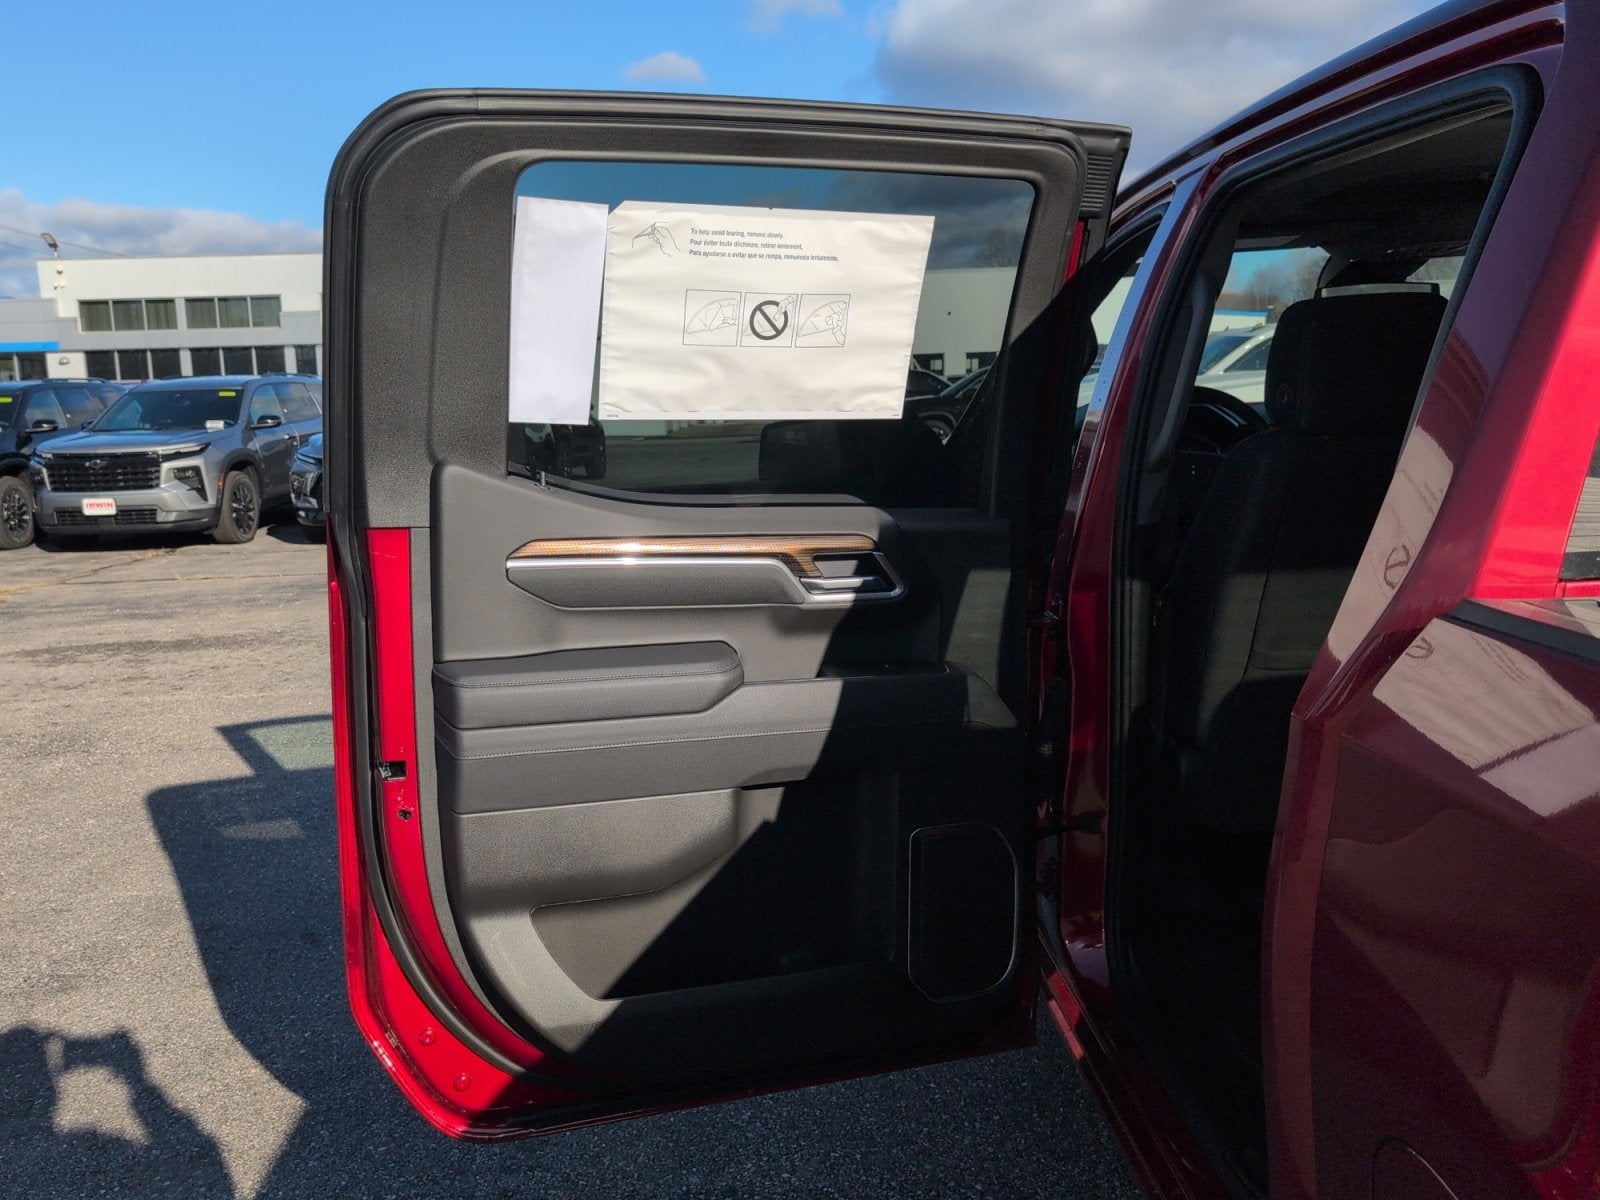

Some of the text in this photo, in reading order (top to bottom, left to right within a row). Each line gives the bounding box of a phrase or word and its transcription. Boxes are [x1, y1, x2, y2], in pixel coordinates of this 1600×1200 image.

[767, 232, 784, 240] slowly.
[690, 238, 702, 246] Pour
[689, 248, 702, 256] Para
[702, 250, 727, 258] ayudarse
[732, 251, 747, 259] evitar
[747, 252, 757, 260] que
